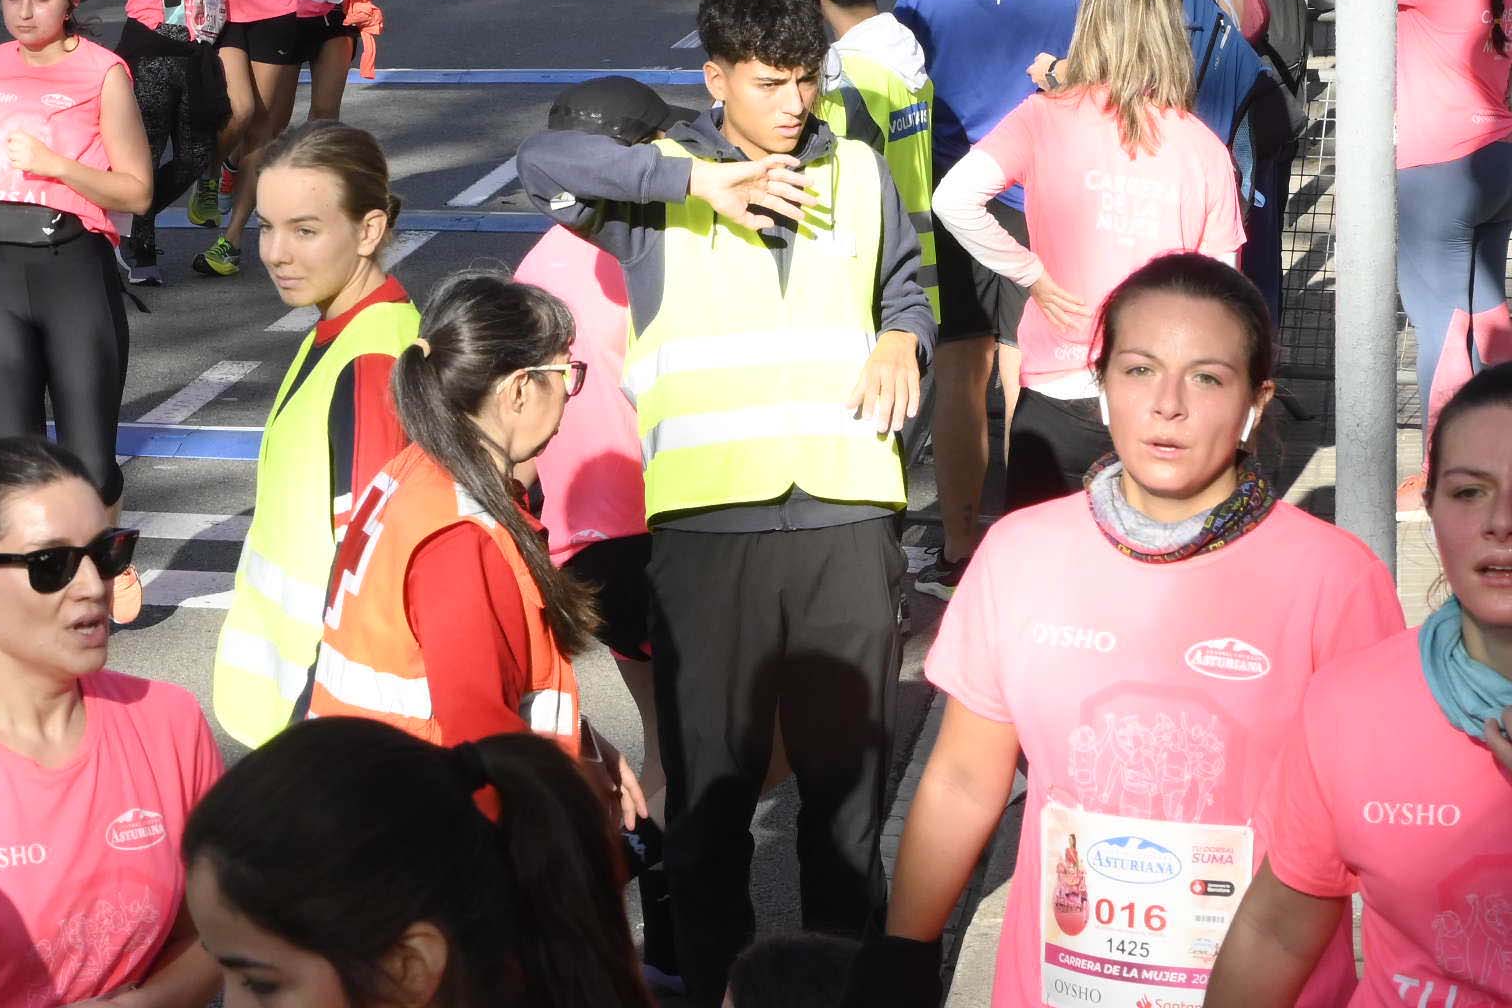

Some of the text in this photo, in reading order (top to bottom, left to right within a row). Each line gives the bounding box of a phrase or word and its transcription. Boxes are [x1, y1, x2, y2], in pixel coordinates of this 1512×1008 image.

[1033, 624, 1117, 653] OYSHO
[1192, 649, 1264, 673] ASTURIANA
[1362, 800, 1461, 826] OYSHO
[110, 824, 165, 844] ASTURIANA
[1093, 849, 1175, 875] ASTURIANA
[1191, 853, 1235, 865] SUMA
[1095, 898, 1168, 932] 016
[1106, 937, 1150, 958] 1425
[1058, 952, 1101, 973] CARRERA
[1103, 964, 1121, 977] DE
[1122, 967, 1138, 979] LA
[1141, 968, 1188, 984] MUJER
[1054, 978, 1102, 1004] OYSHO
